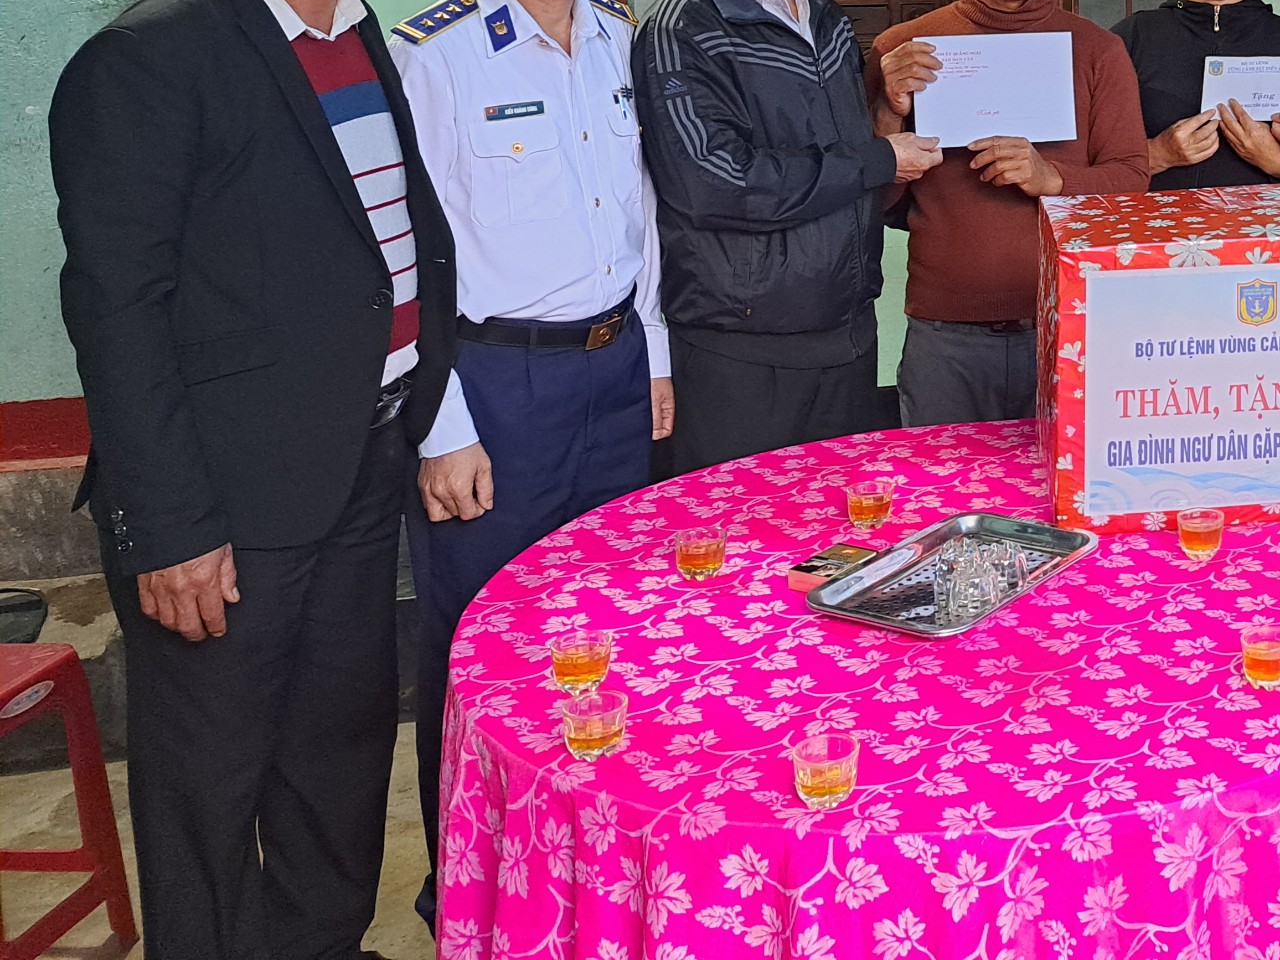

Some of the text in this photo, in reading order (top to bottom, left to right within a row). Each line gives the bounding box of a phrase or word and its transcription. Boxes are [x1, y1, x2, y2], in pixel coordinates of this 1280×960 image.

[1135, 339, 1154, 360] BỘ
[1158, 339, 1177, 357] TƯ
[1180, 337, 1215, 358] LỆNH
[1219, 335, 1256, 354] VÙNG
[1115, 378, 1220, 420] THĂM,
[1107, 440, 1134, 467] GIA
[1138, 433, 1175, 466] ĐÌNH
[1180, 433, 1214, 463] NGƯ
[1216, 429, 1248, 461] DÂN
